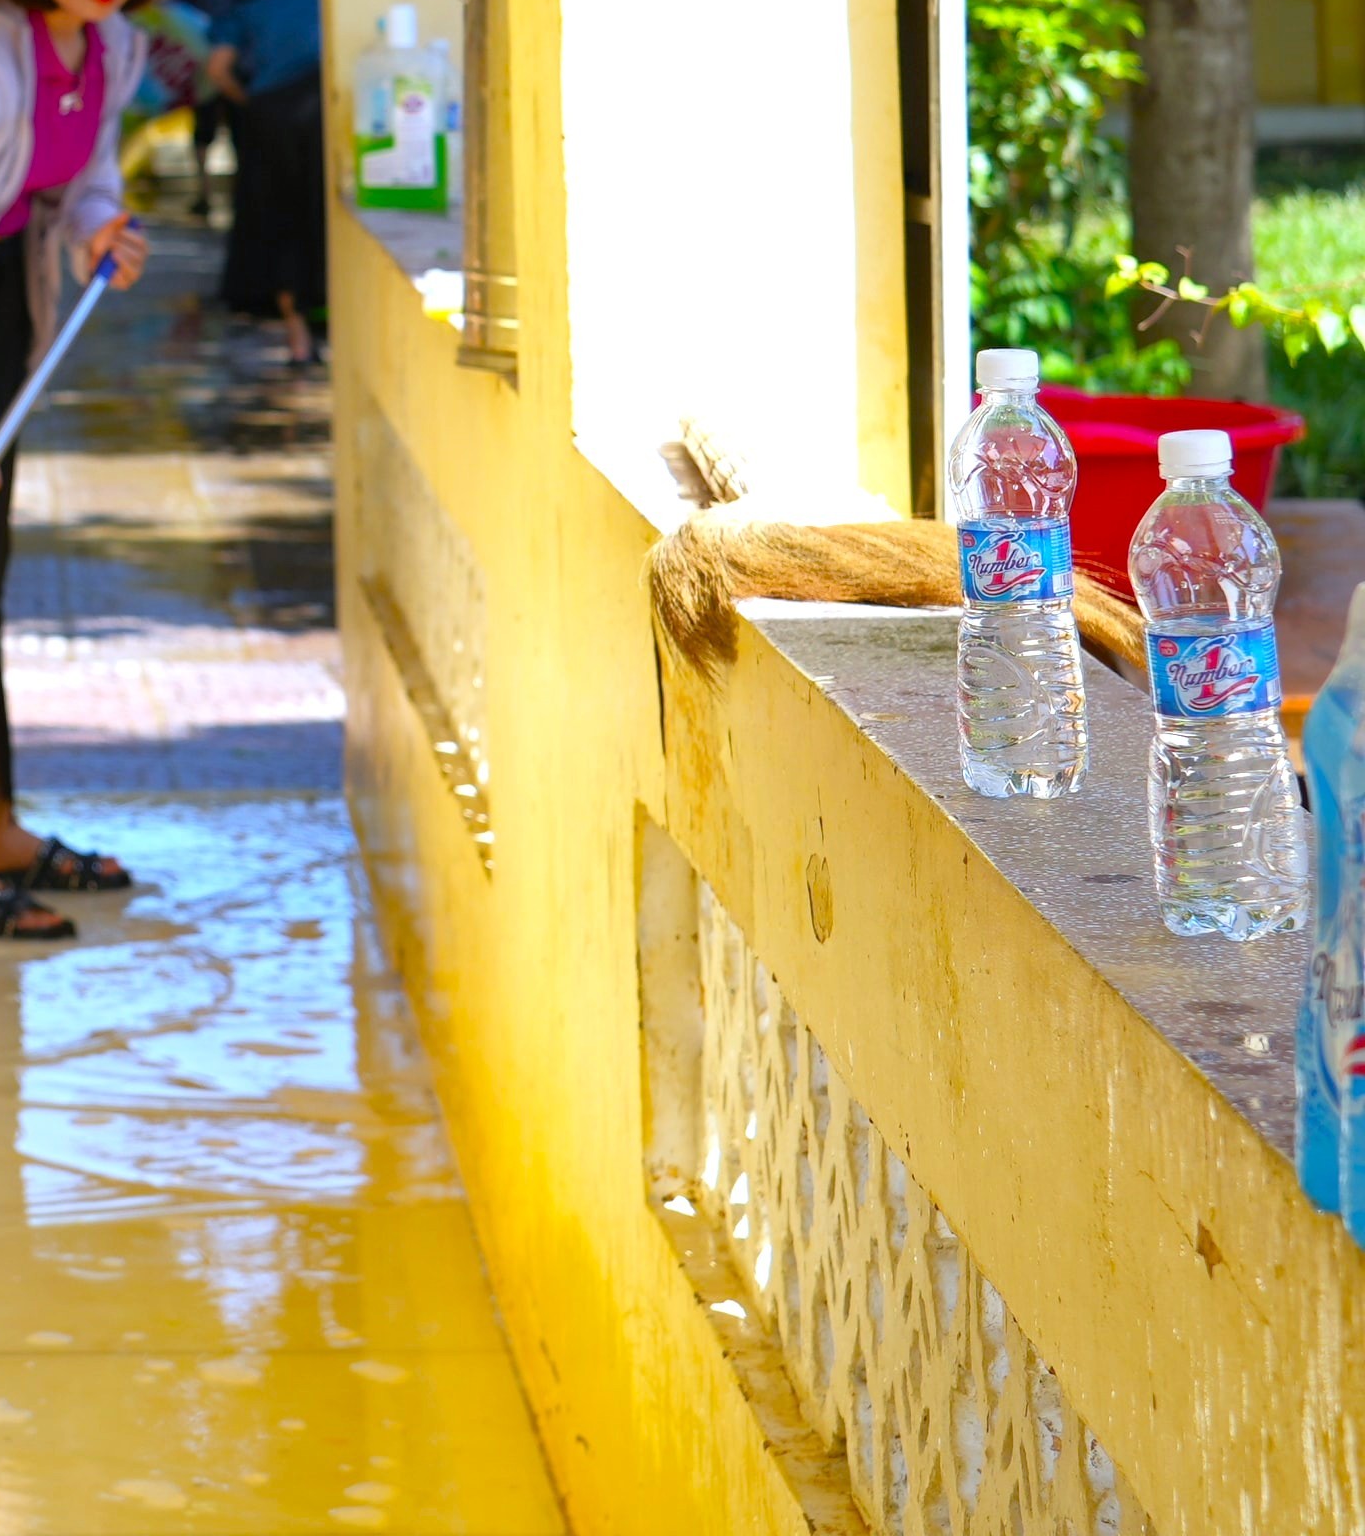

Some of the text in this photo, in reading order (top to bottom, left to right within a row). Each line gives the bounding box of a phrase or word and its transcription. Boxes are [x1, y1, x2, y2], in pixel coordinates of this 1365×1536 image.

[969, 549, 1041, 579] Number
[988, 541, 1011, 585] 1
[1169, 646, 1253, 700] Number 1
